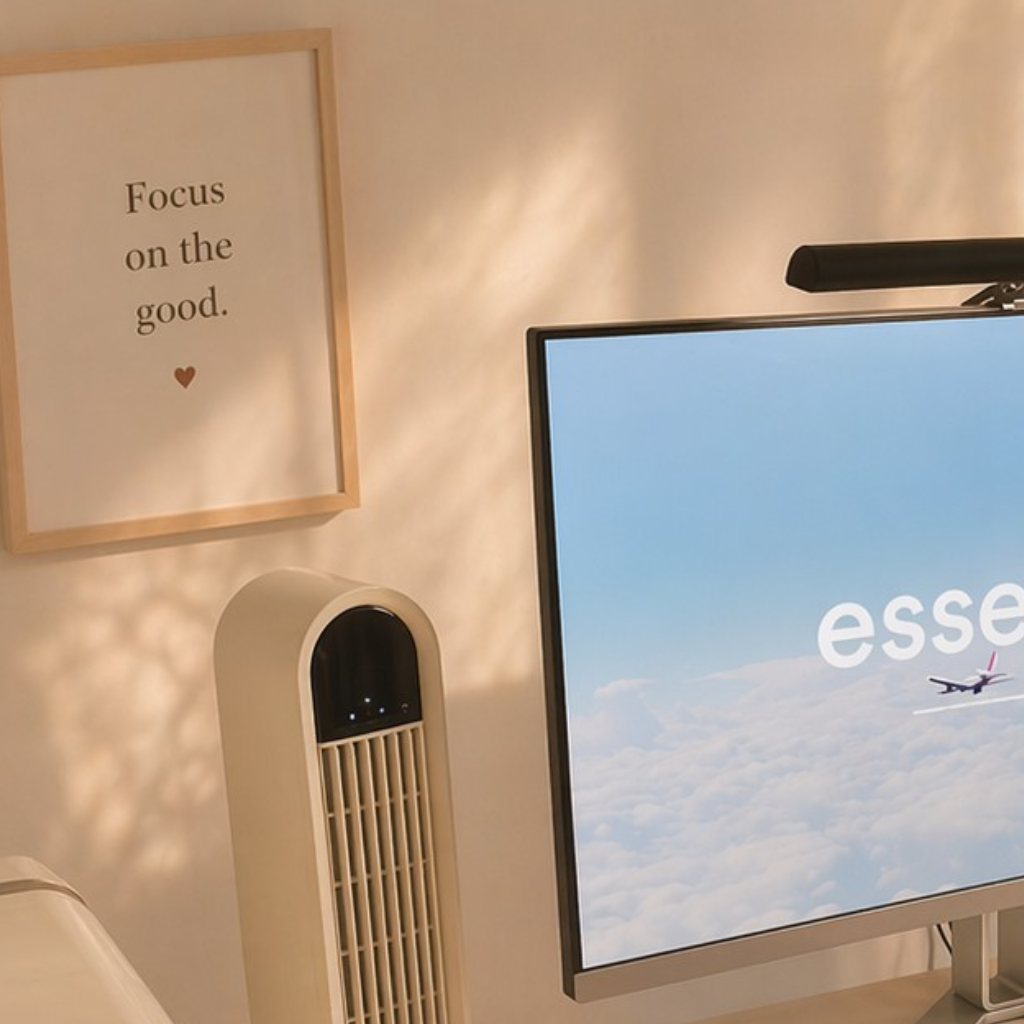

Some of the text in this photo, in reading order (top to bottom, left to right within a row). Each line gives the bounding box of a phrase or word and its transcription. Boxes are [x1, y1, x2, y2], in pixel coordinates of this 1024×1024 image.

[125, 181, 225, 214] Focus
[125, 230, 233, 271] on the
[136, 285, 228, 336] good.
